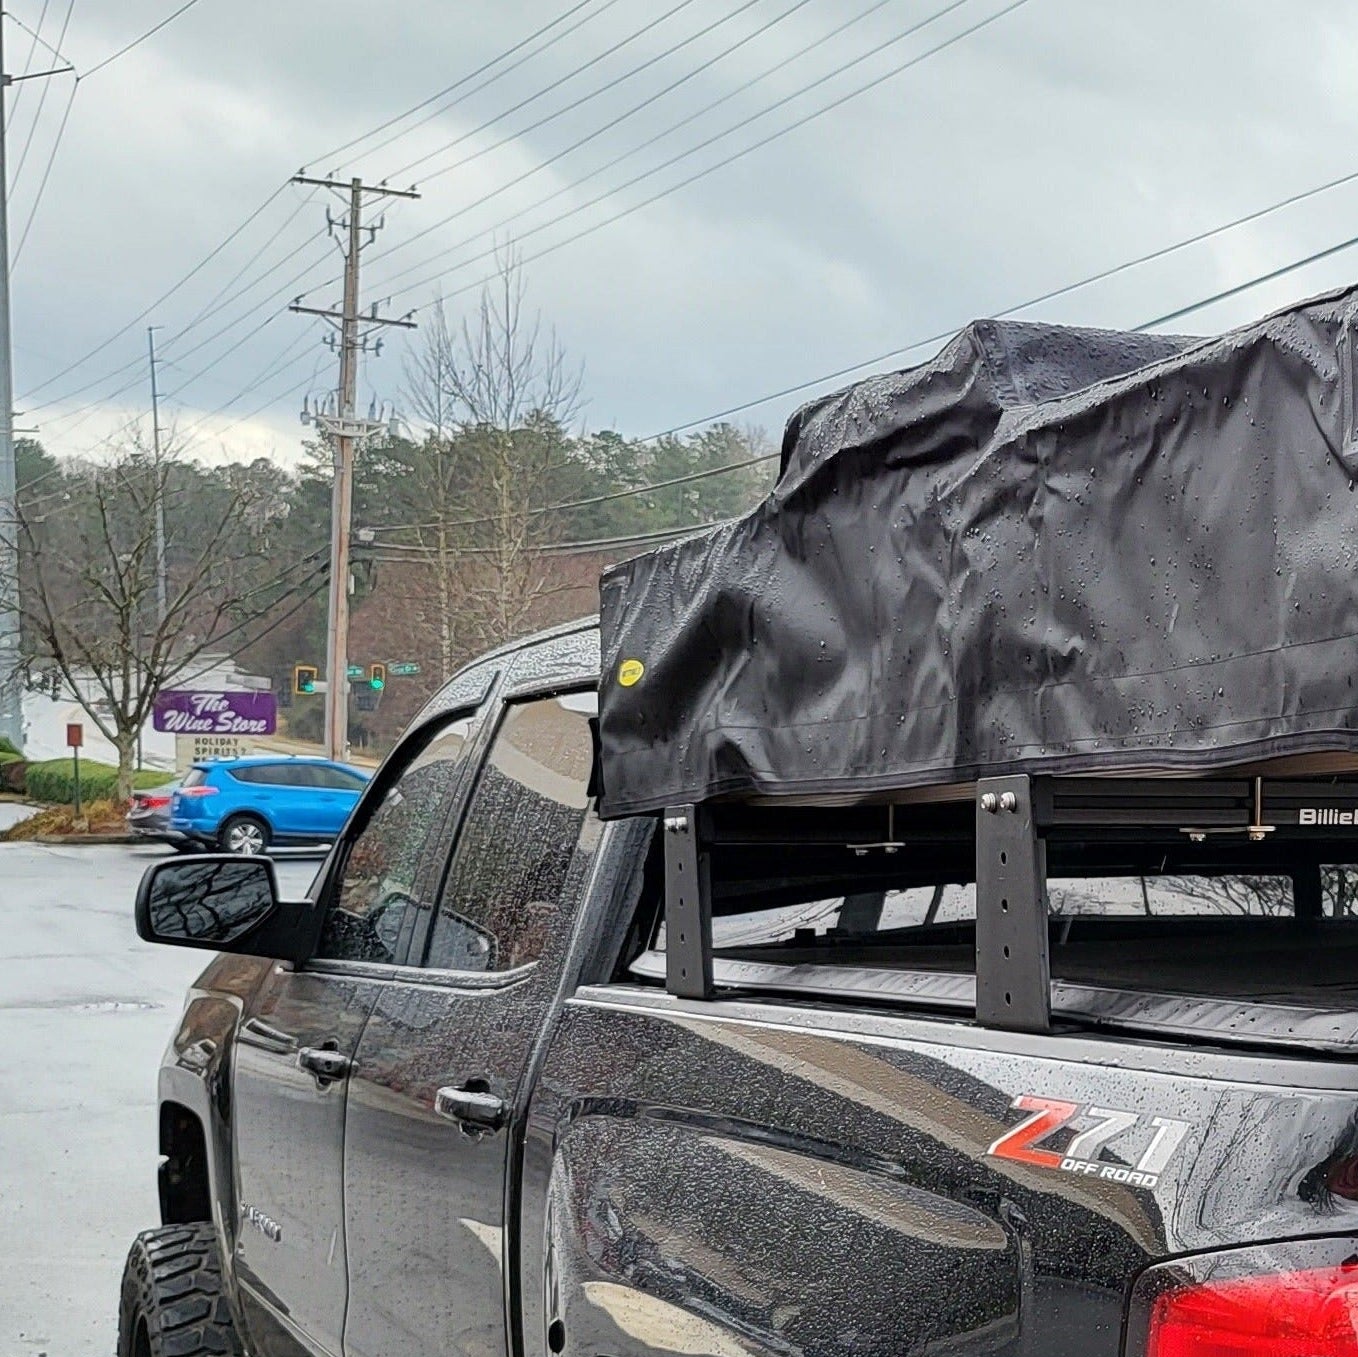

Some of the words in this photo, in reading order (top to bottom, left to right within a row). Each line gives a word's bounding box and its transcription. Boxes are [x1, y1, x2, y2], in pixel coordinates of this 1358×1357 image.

[191, 694, 230, 715] The
[163, 709, 213, 732] Wine
[214, 710, 267, 732] Store
[194, 737, 238, 746] HOLIDAY
[987, 1095, 1191, 1174] Z71
[1060, 1158, 1099, 1175] OFF
[1100, 1165, 1158, 1187] ROAD
